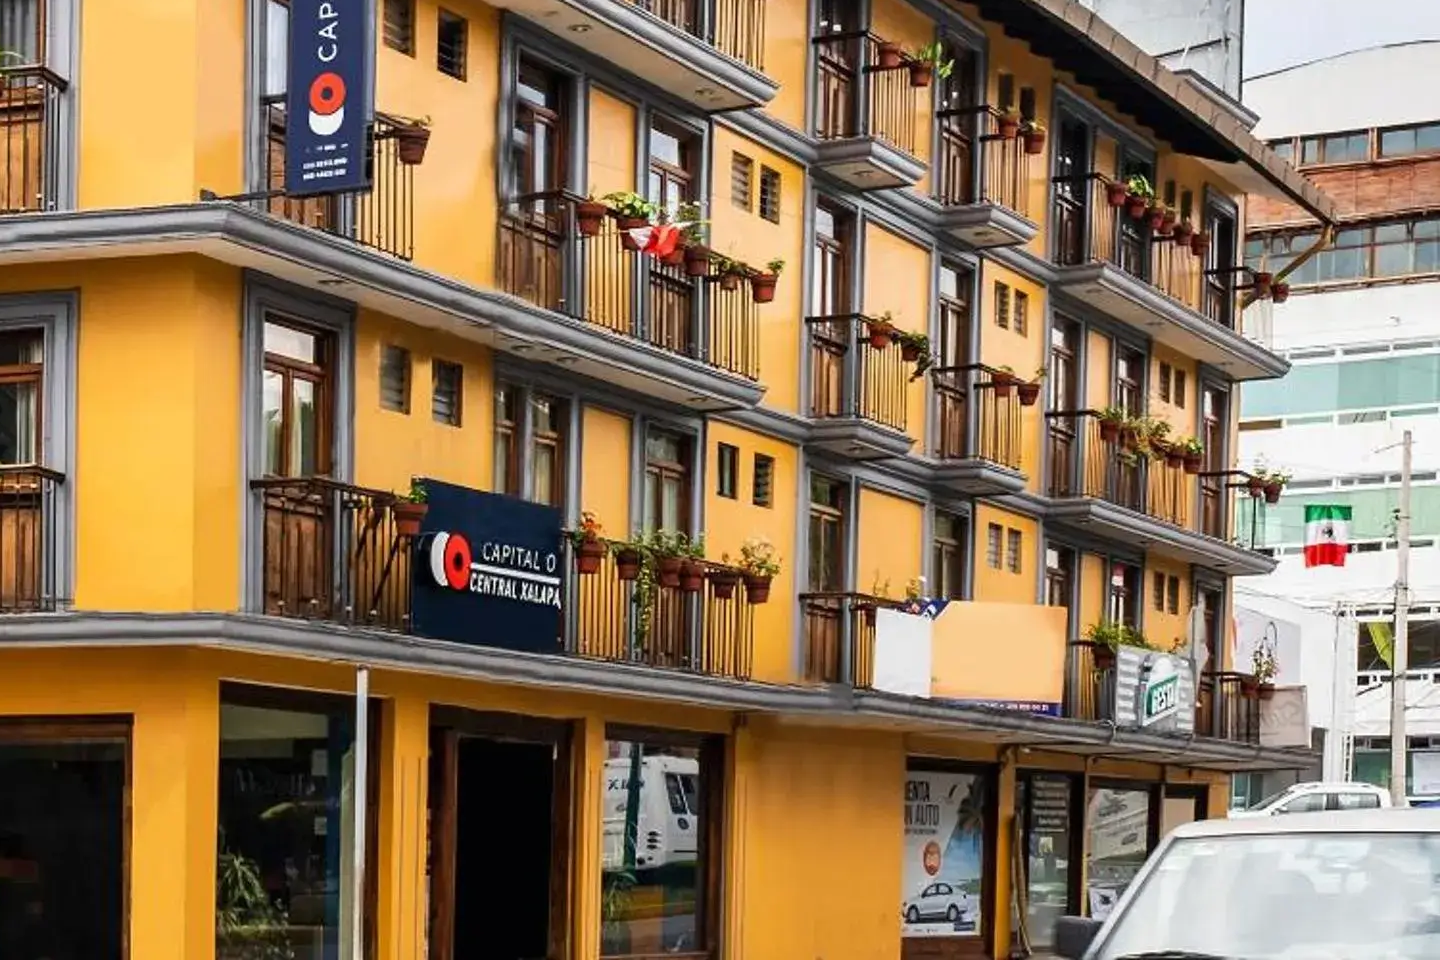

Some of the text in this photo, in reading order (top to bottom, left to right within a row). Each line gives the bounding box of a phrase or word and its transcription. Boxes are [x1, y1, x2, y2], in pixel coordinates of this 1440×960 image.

[482, 542, 541, 570] CAPITAL
[469, 573, 562, 609] CENTRAL XALAPA
